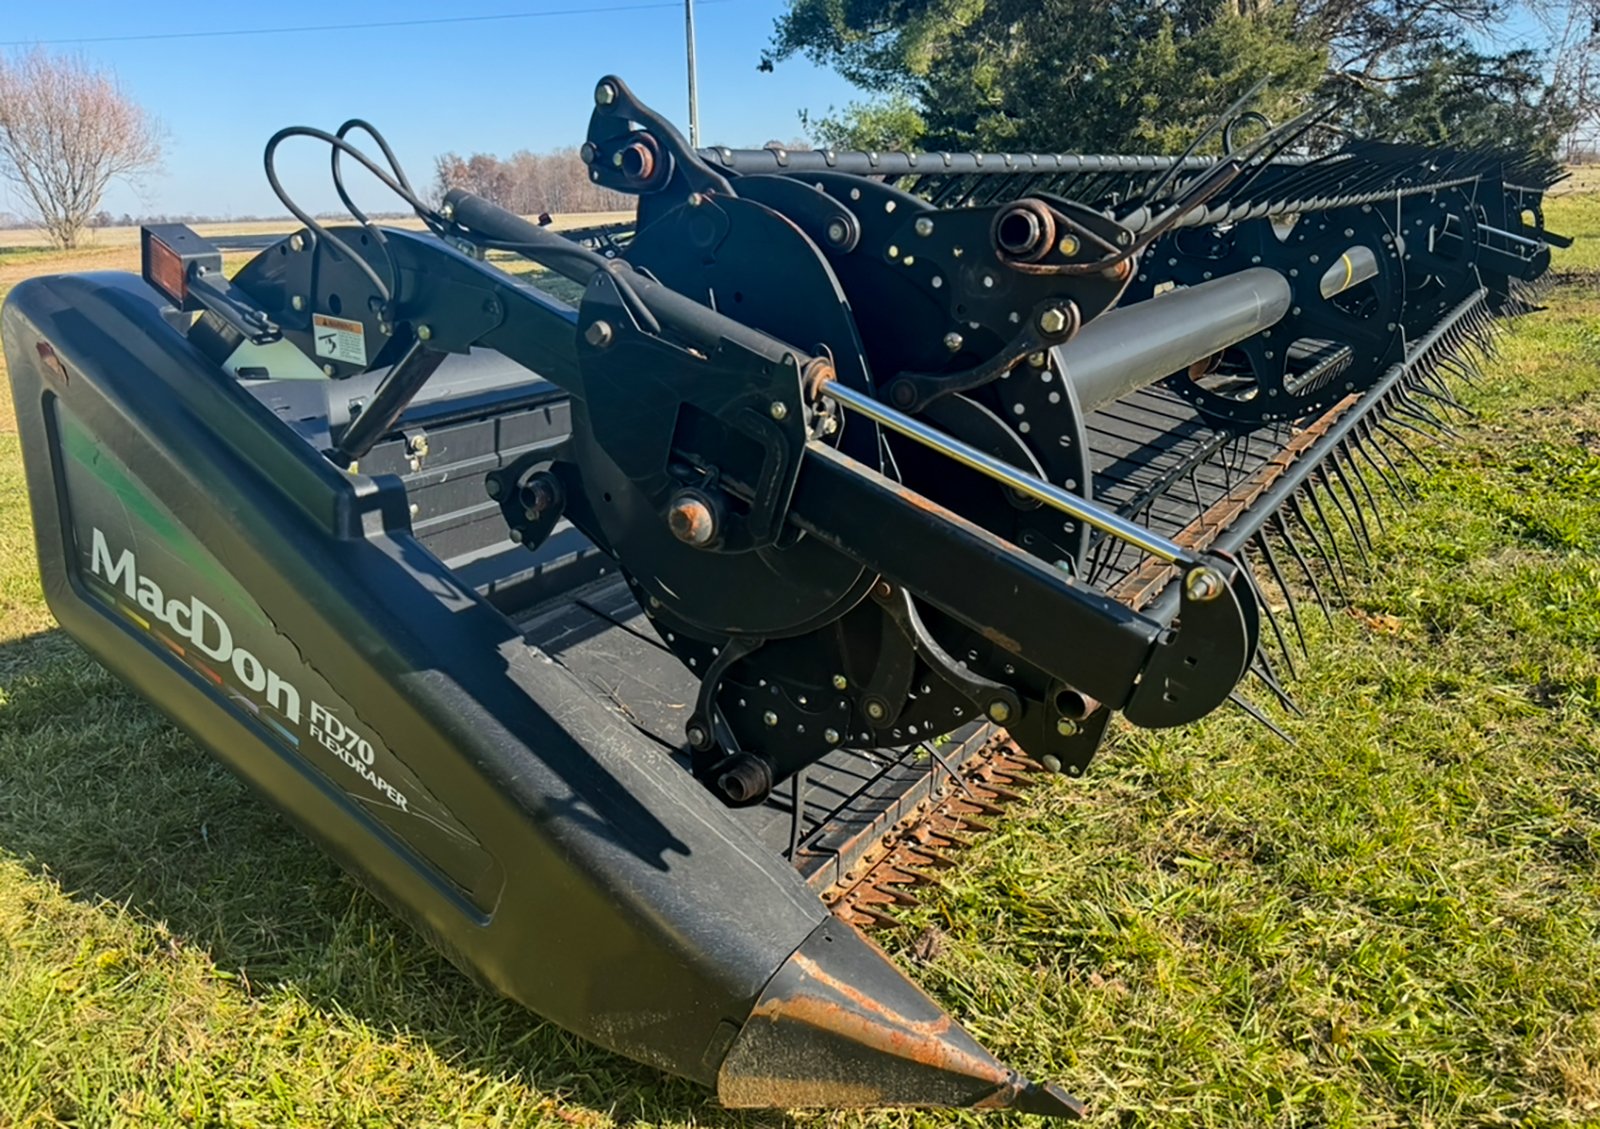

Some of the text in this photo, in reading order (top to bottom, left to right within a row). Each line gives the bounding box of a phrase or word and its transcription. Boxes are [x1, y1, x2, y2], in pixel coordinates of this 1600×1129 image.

[91, 527, 300, 725] MacDon
[310, 724, 409, 811] FLEXDRAPER
[311, 701, 374, 765] FD70
